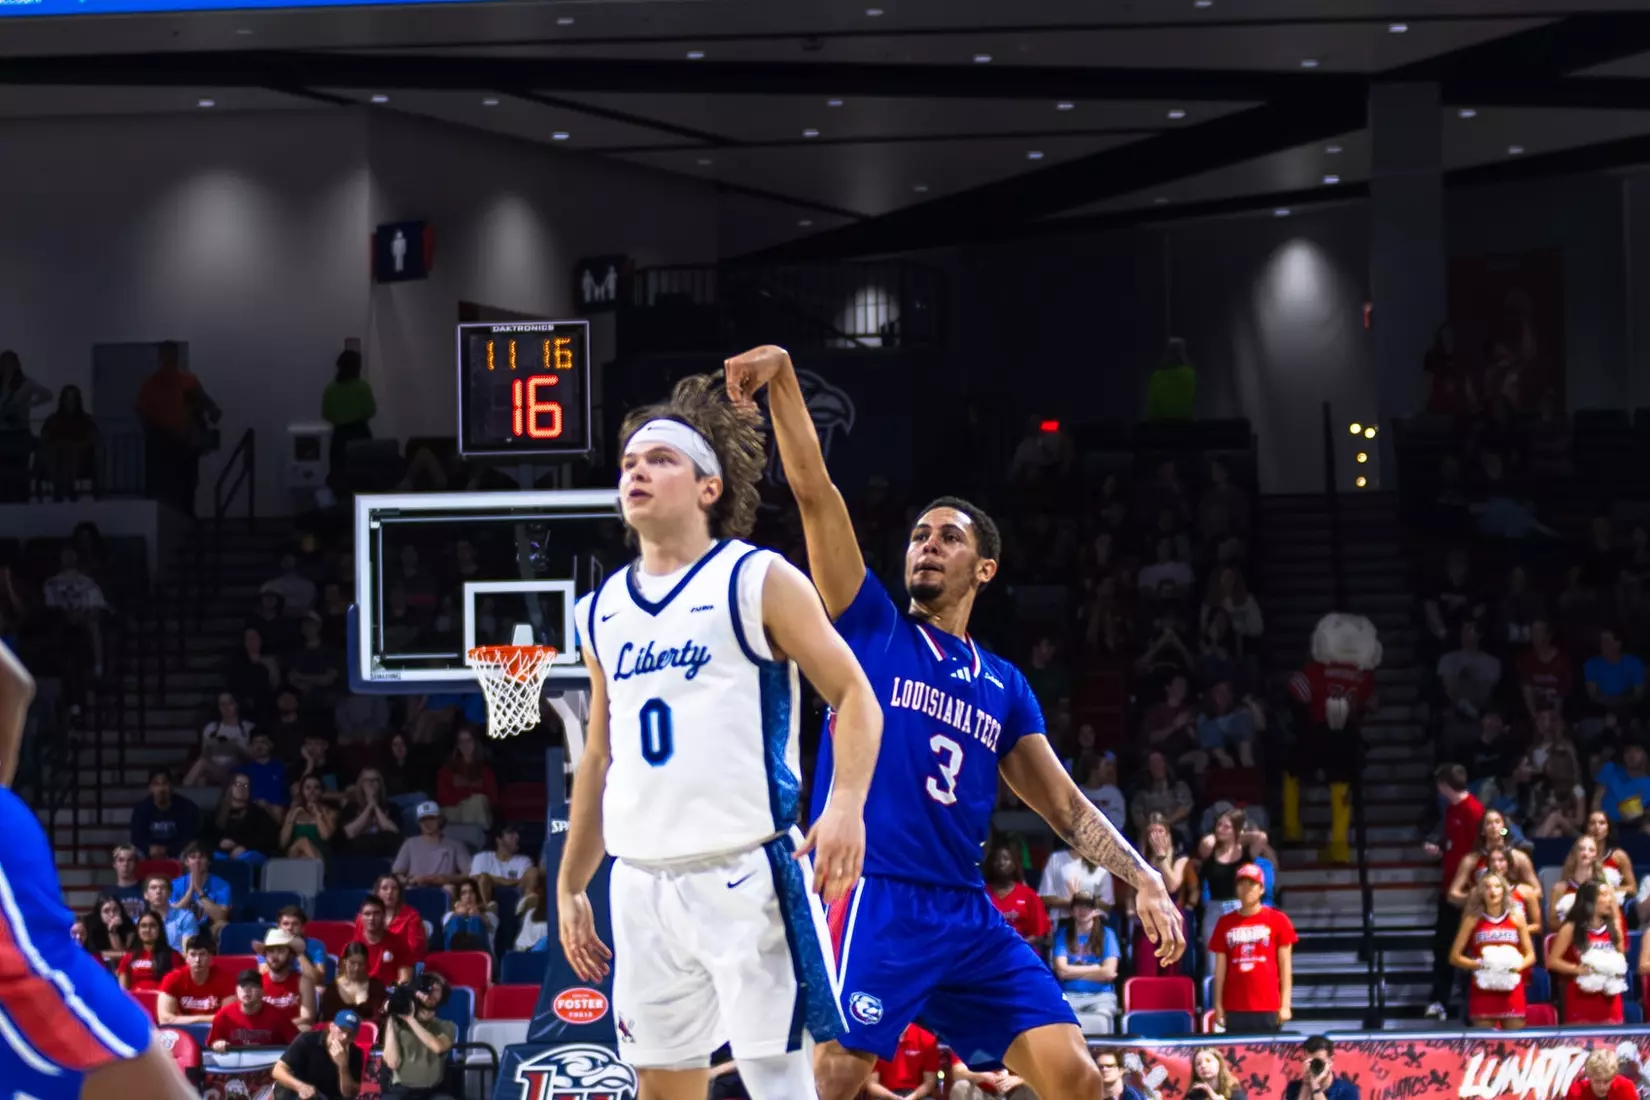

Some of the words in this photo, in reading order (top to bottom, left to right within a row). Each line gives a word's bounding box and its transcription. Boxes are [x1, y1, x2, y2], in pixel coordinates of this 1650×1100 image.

[492, 324, 555, 333] DAKTRONICS
[543, 337, 573, 369] 16
[512, 374, 562, 440] 16
[613, 639, 711, 681] Liberty
[890, 676, 972, 734] LOUISIANA
[639, 696, 675, 768] 0
[926, 733, 964, 805] 3
[557, 998, 604, 1010] FOSTER
